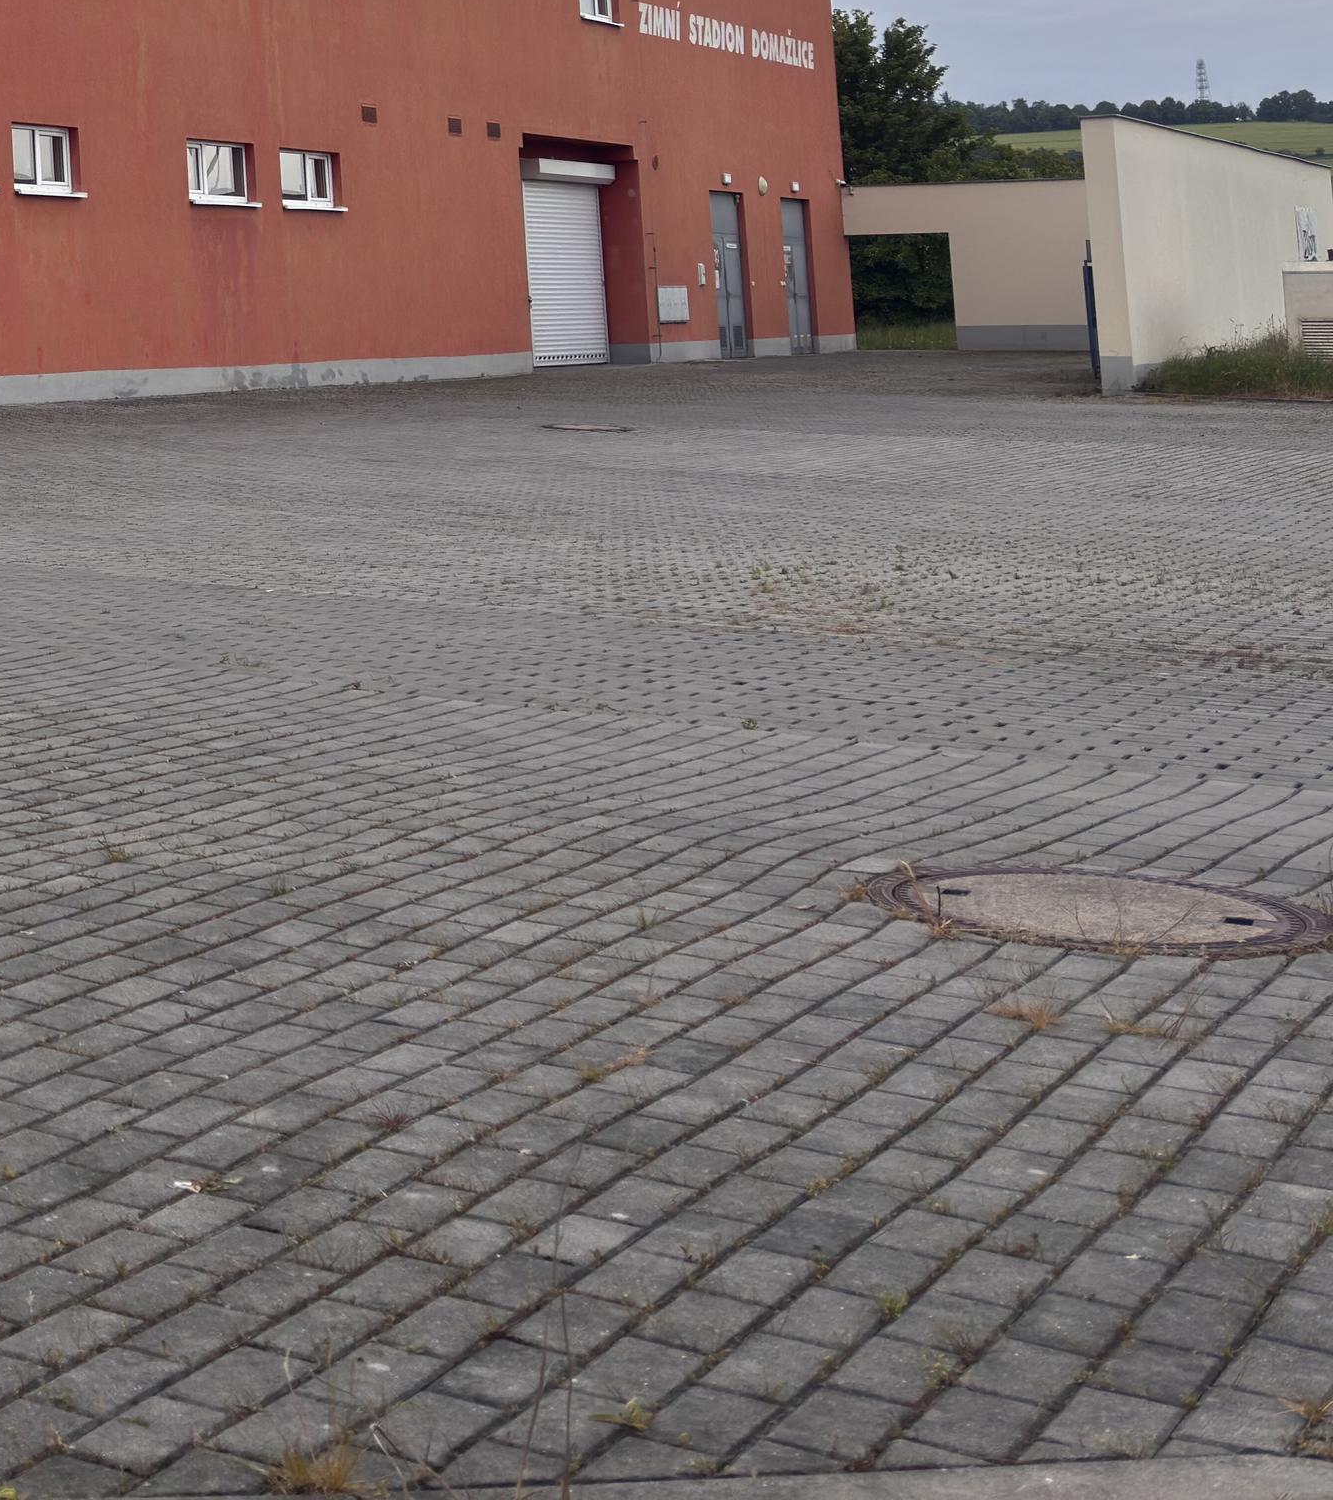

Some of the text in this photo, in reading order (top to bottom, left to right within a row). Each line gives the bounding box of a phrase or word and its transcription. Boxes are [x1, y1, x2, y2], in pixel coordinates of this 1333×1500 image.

[638, 1, 815, 70] ZIMNÍ STADION DOMAŽLICE
